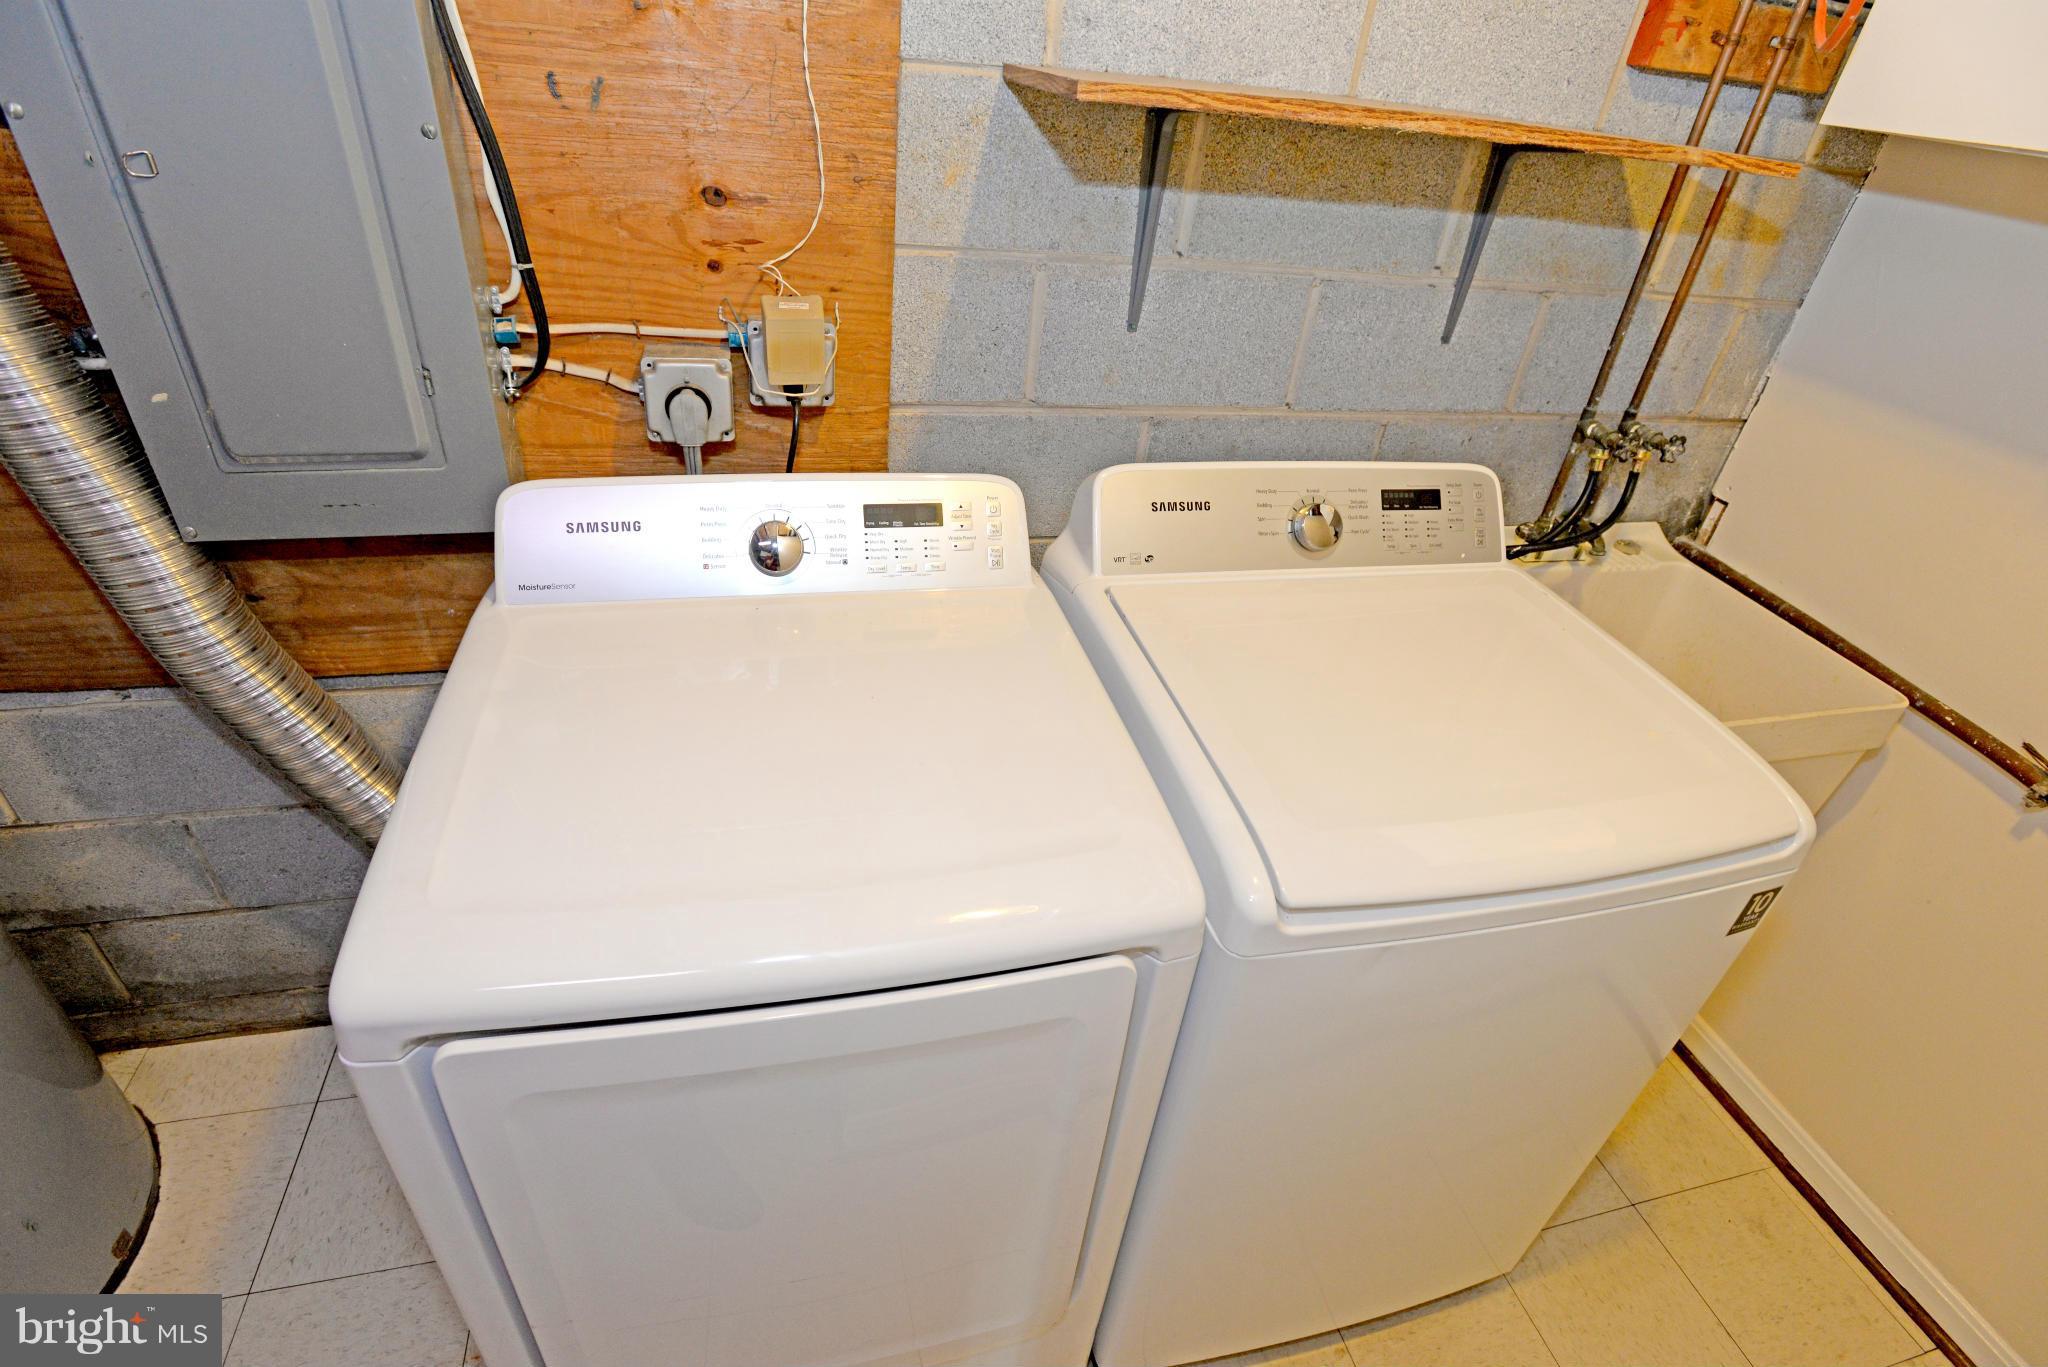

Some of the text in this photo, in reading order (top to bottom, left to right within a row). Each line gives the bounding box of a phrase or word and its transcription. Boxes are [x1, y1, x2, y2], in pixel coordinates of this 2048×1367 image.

[1151, 501, 1211, 512] SAMSUNG
[565, 520, 642, 535] SAMSUNG
[518, 582, 576, 592] MoistureSensor
[1746, 891, 1775, 915] 10
